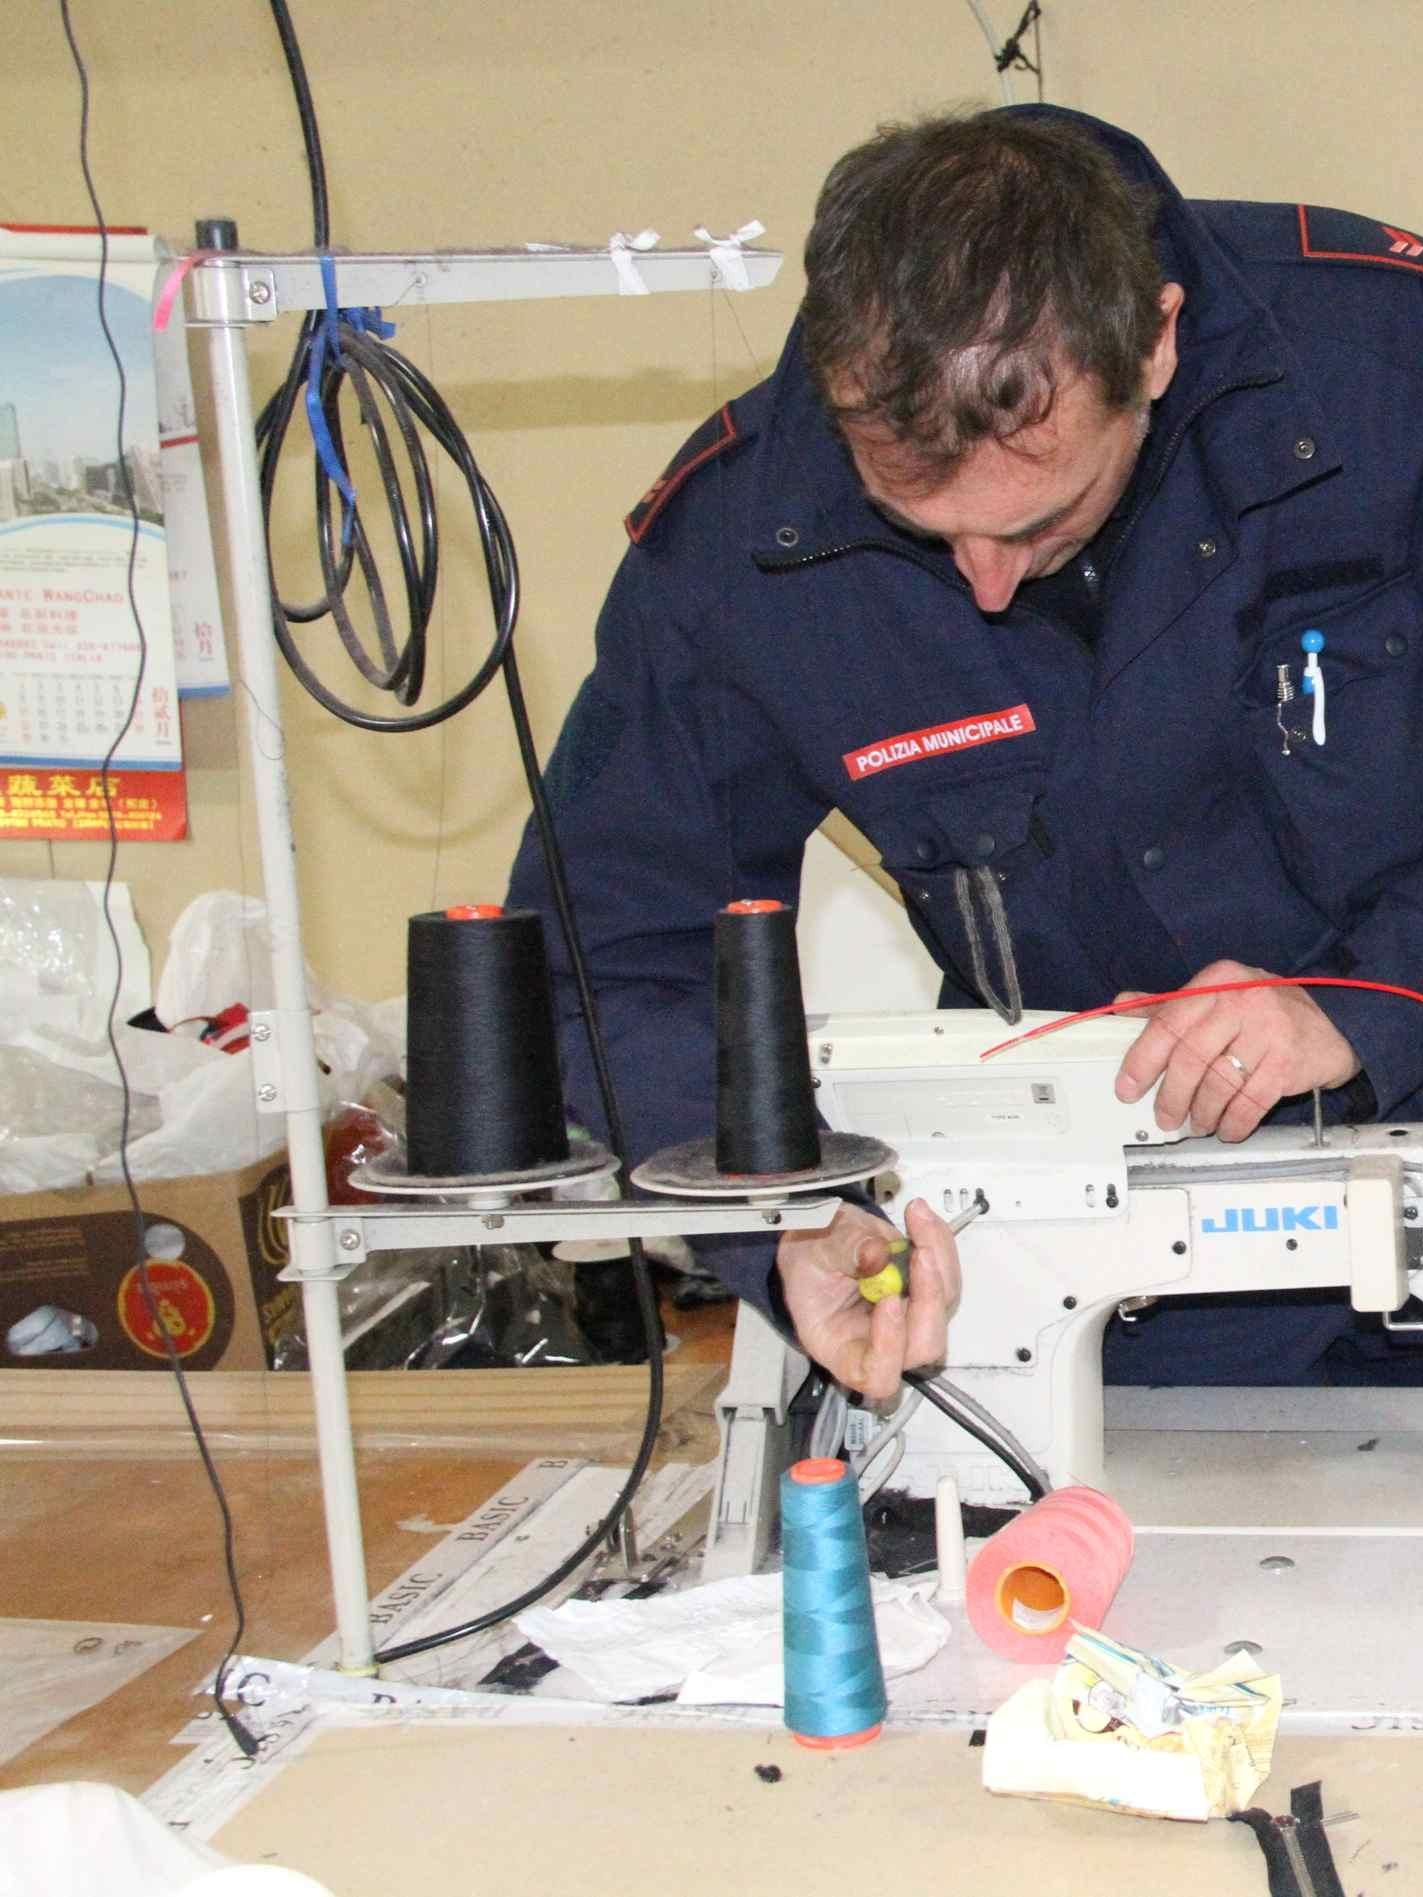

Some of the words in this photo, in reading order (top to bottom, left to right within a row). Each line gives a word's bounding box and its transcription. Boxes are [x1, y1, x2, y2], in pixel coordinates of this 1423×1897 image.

[856, 742, 922, 773] POLIZIA
[922, 713, 1024, 752] MUNICIPALE
[1201, 1205, 1339, 1233] JUKI
[368, 1572, 443, 1625] BASIC
[454, 1495, 530, 1542] BASIC
